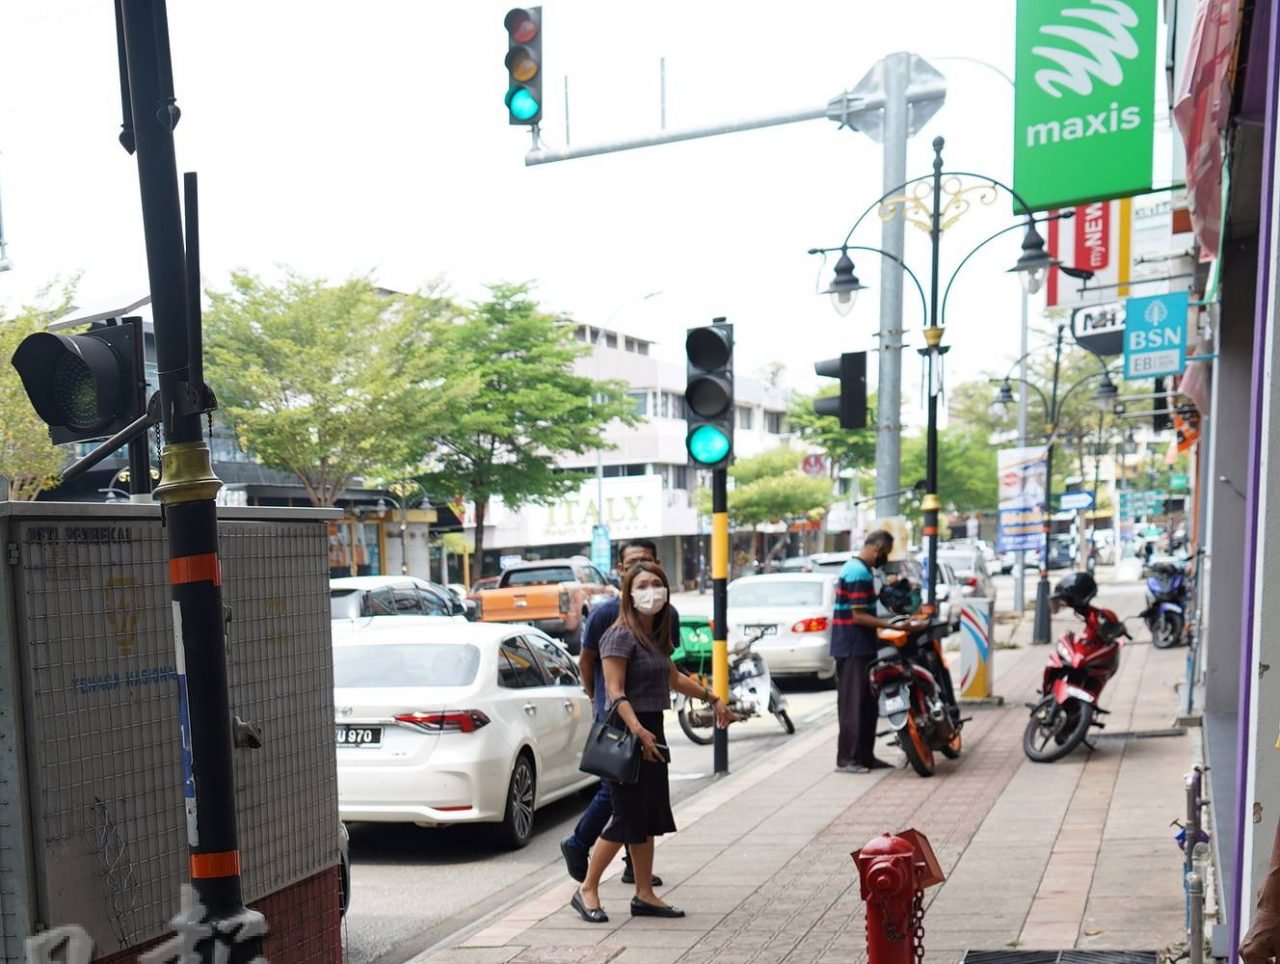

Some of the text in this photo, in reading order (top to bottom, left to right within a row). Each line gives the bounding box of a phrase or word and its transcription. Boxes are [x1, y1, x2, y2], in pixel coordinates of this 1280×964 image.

[1026, 102, 1141, 147] maxis
[1130, 326, 1181, 351] BSN
[546, 496, 643, 526] ITALY
[348, 729, 372, 742] 970
